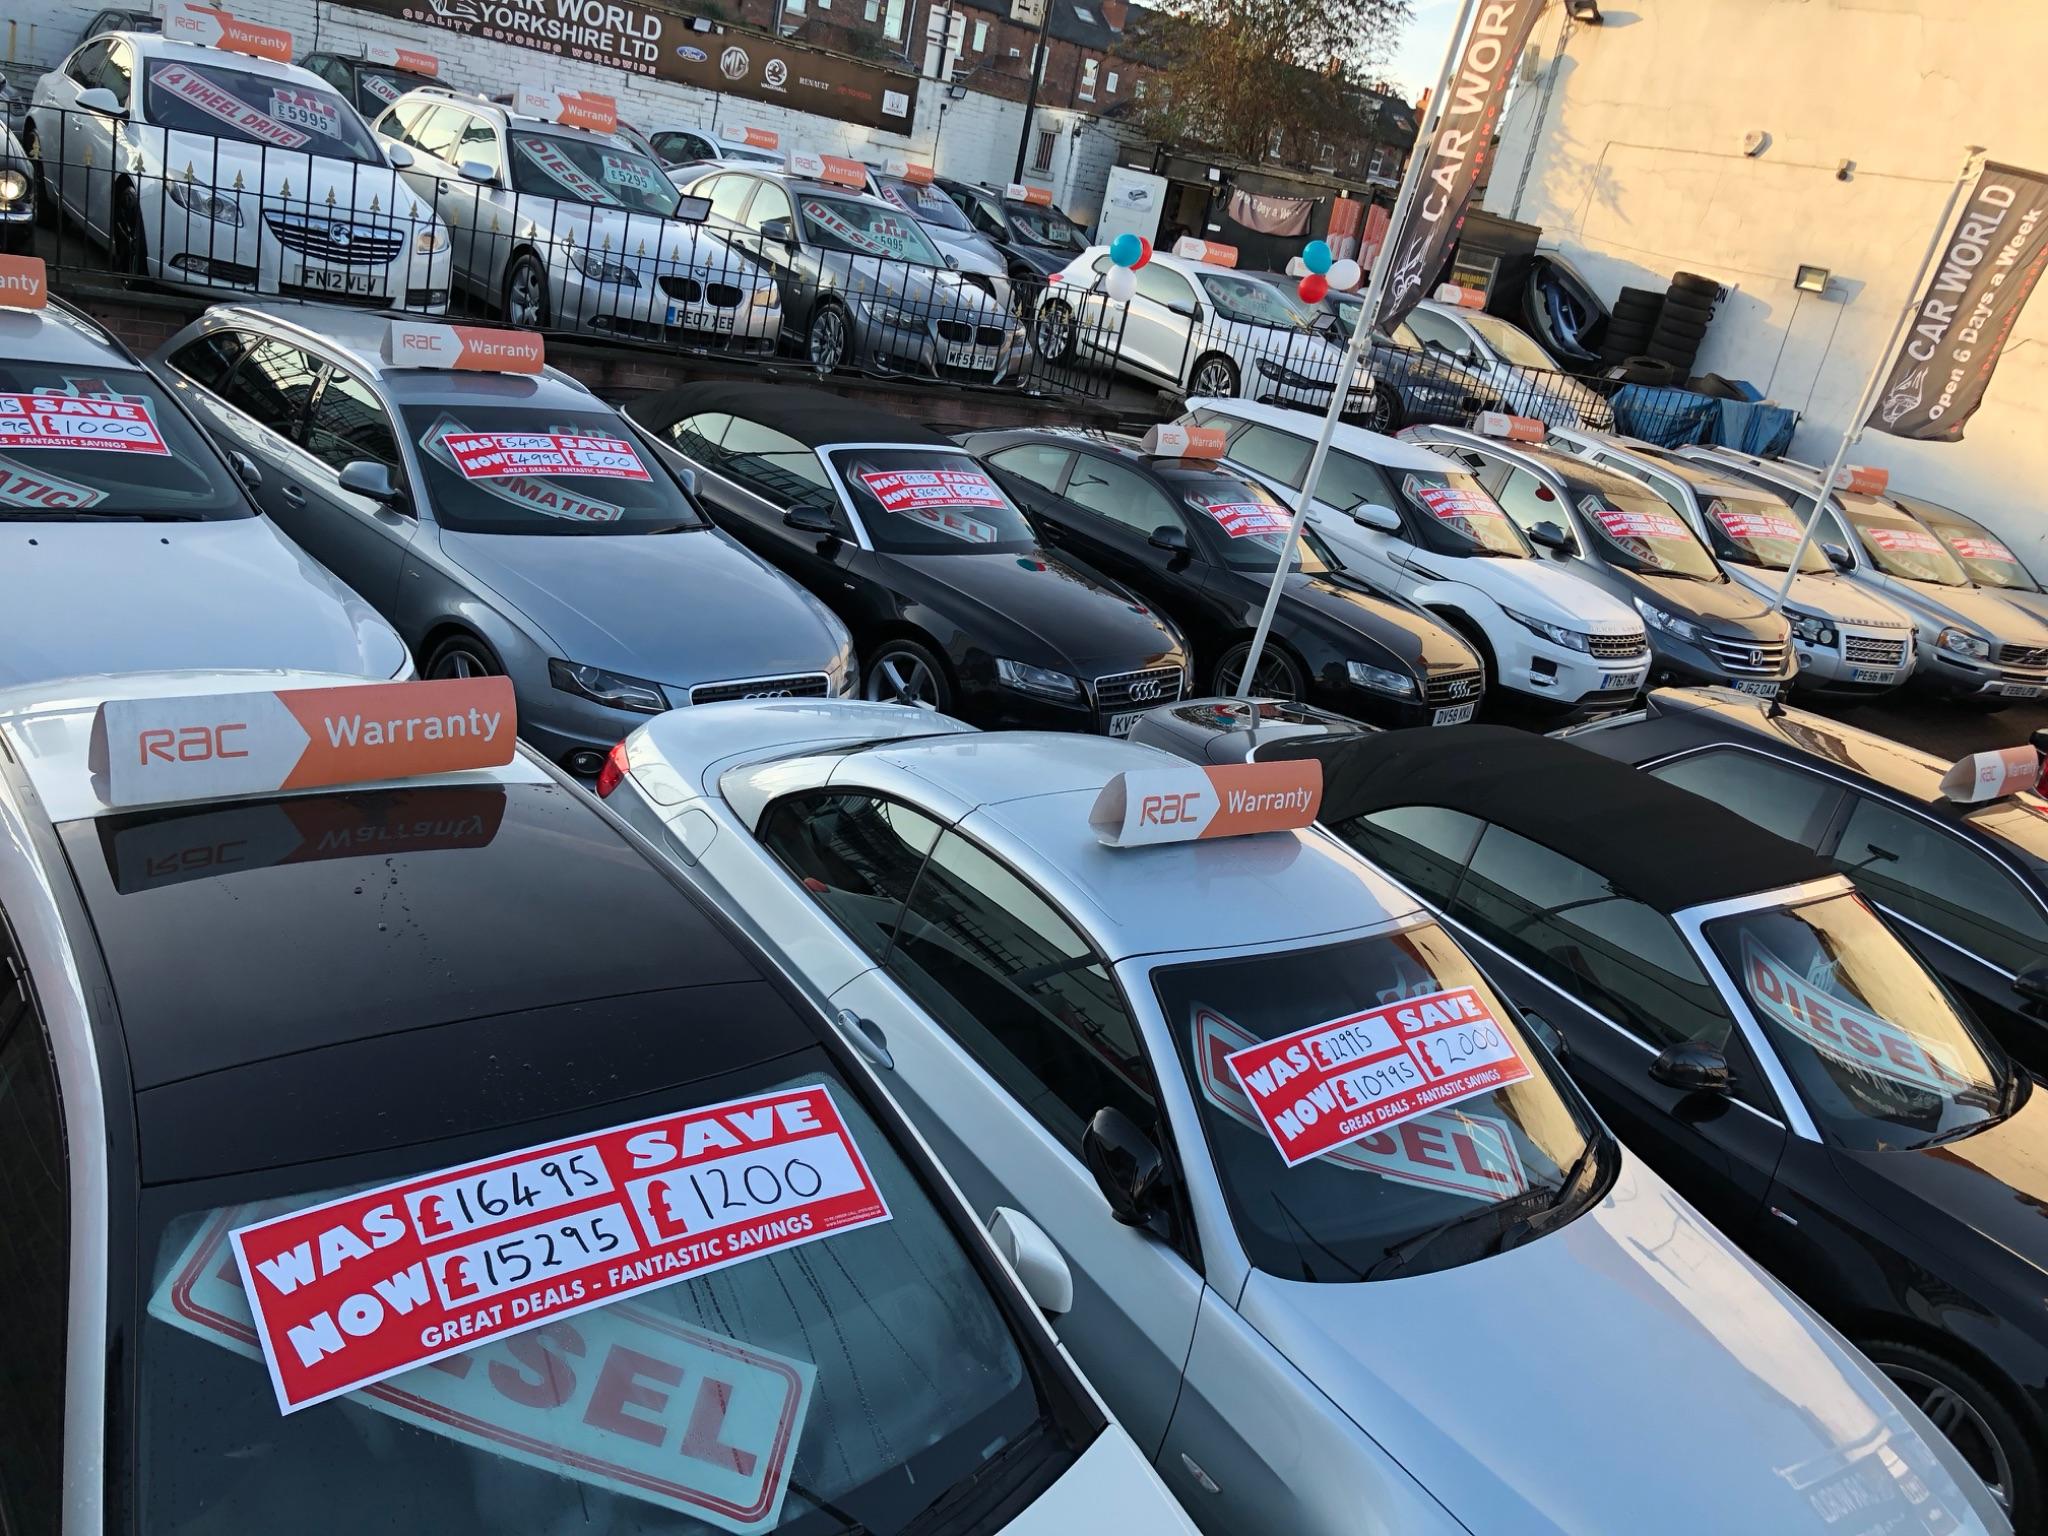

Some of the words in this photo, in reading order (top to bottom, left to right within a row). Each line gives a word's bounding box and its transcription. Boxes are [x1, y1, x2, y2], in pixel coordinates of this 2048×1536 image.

[480, 5, 614, 51] YORKSHIRE
[620, 37, 660, 62] LTD
[556, 0, 662, 41] WORLD
[228, 27, 287, 51] Warranty
[402, 8, 473, 32] QUALITY
[483, 27, 562, 54] MOTORING
[571, 47, 657, 75] WORLDWIDE
[401, 53, 435, 71] Warranty
[724, 50, 746, 77] MG
[371, 82, 398, 101] LOW
[799, 77, 829, 90] RENAULT
[167, 73, 181, 85] 4
[180, 79, 240, 118] WHEEL
[241, 114, 297, 147] DRIVE
[567, 103, 613, 125] Warranty
[527, 138, 608, 203] DIESEL
[828, 163, 865, 181] Warranty
[1421, 128, 1474, 222] CAR
[1995, 207, 2042, 266] Week
[1208, 247, 1236, 261] Warranty
[1908, 299, 1958, 361] CAR
[1935, 184, 2016, 293] WORLD
[1991, 272, 2006, 286] a
[1958, 291, 1994, 344] Days
[469, 339, 538, 361] Warranty
[1953, 348, 1971, 364] 6
[1928, 368, 1964, 420] Open
[32, 400, 139, 419] SAVE
[42, 415, 147, 437] £1000
[20, 437, 76, 446] FANTASTIC
[80, 439, 127, 449] SAVINGS
[451, 437, 493, 453] WAS
[495, 437, 551, 449] £5495
[559, 437, 628, 453] SAVE
[1191, 436, 1223, 449] Warranty
[463, 453, 502, 470] NOW
[506, 452, 563, 465] £4995
[568, 449, 631, 467] £500
[870, 475, 900, 490] WAS
[940, 473, 984, 485] SAVE
[882, 488, 909, 504] NOW
[324, 707, 501, 749] Warranty
[1228, 786, 1313, 814] Warranty
[1754, 953, 1964, 1086] DIESEL
[1245, 1045, 1311, 1098] WAS
[1396, 995, 1482, 1033] SAVE
[1274, 1084, 1337, 1142] NOW
[1337, 1061, 1415, 1106] £10995
[1418, 1026, 1499, 1078] £2000
[1339, 1110, 1376, 1135] GREAT
[1378, 1099, 1410, 1120] DEALS
[1416, 1081, 1462, 1106] FANTASTIC
[1463, 1068, 1501, 1092] SAVINGS
[256, 1204, 406, 1296] WAS
[416, 1154, 599, 1235] £16495
[625, 1099, 822, 1169] SAVE
[286, 1260, 431, 1368] NOW
[442, 1217, 620, 1301] £15295
[646, 1157, 823, 1240] £1200
[421, 1304, 505, 1349] GREAT
[511, 1280, 586, 1322] DEALS
[608, 1239, 723, 1290] FANTASTIC
[727, 1213, 814, 1252] SAVINGS
